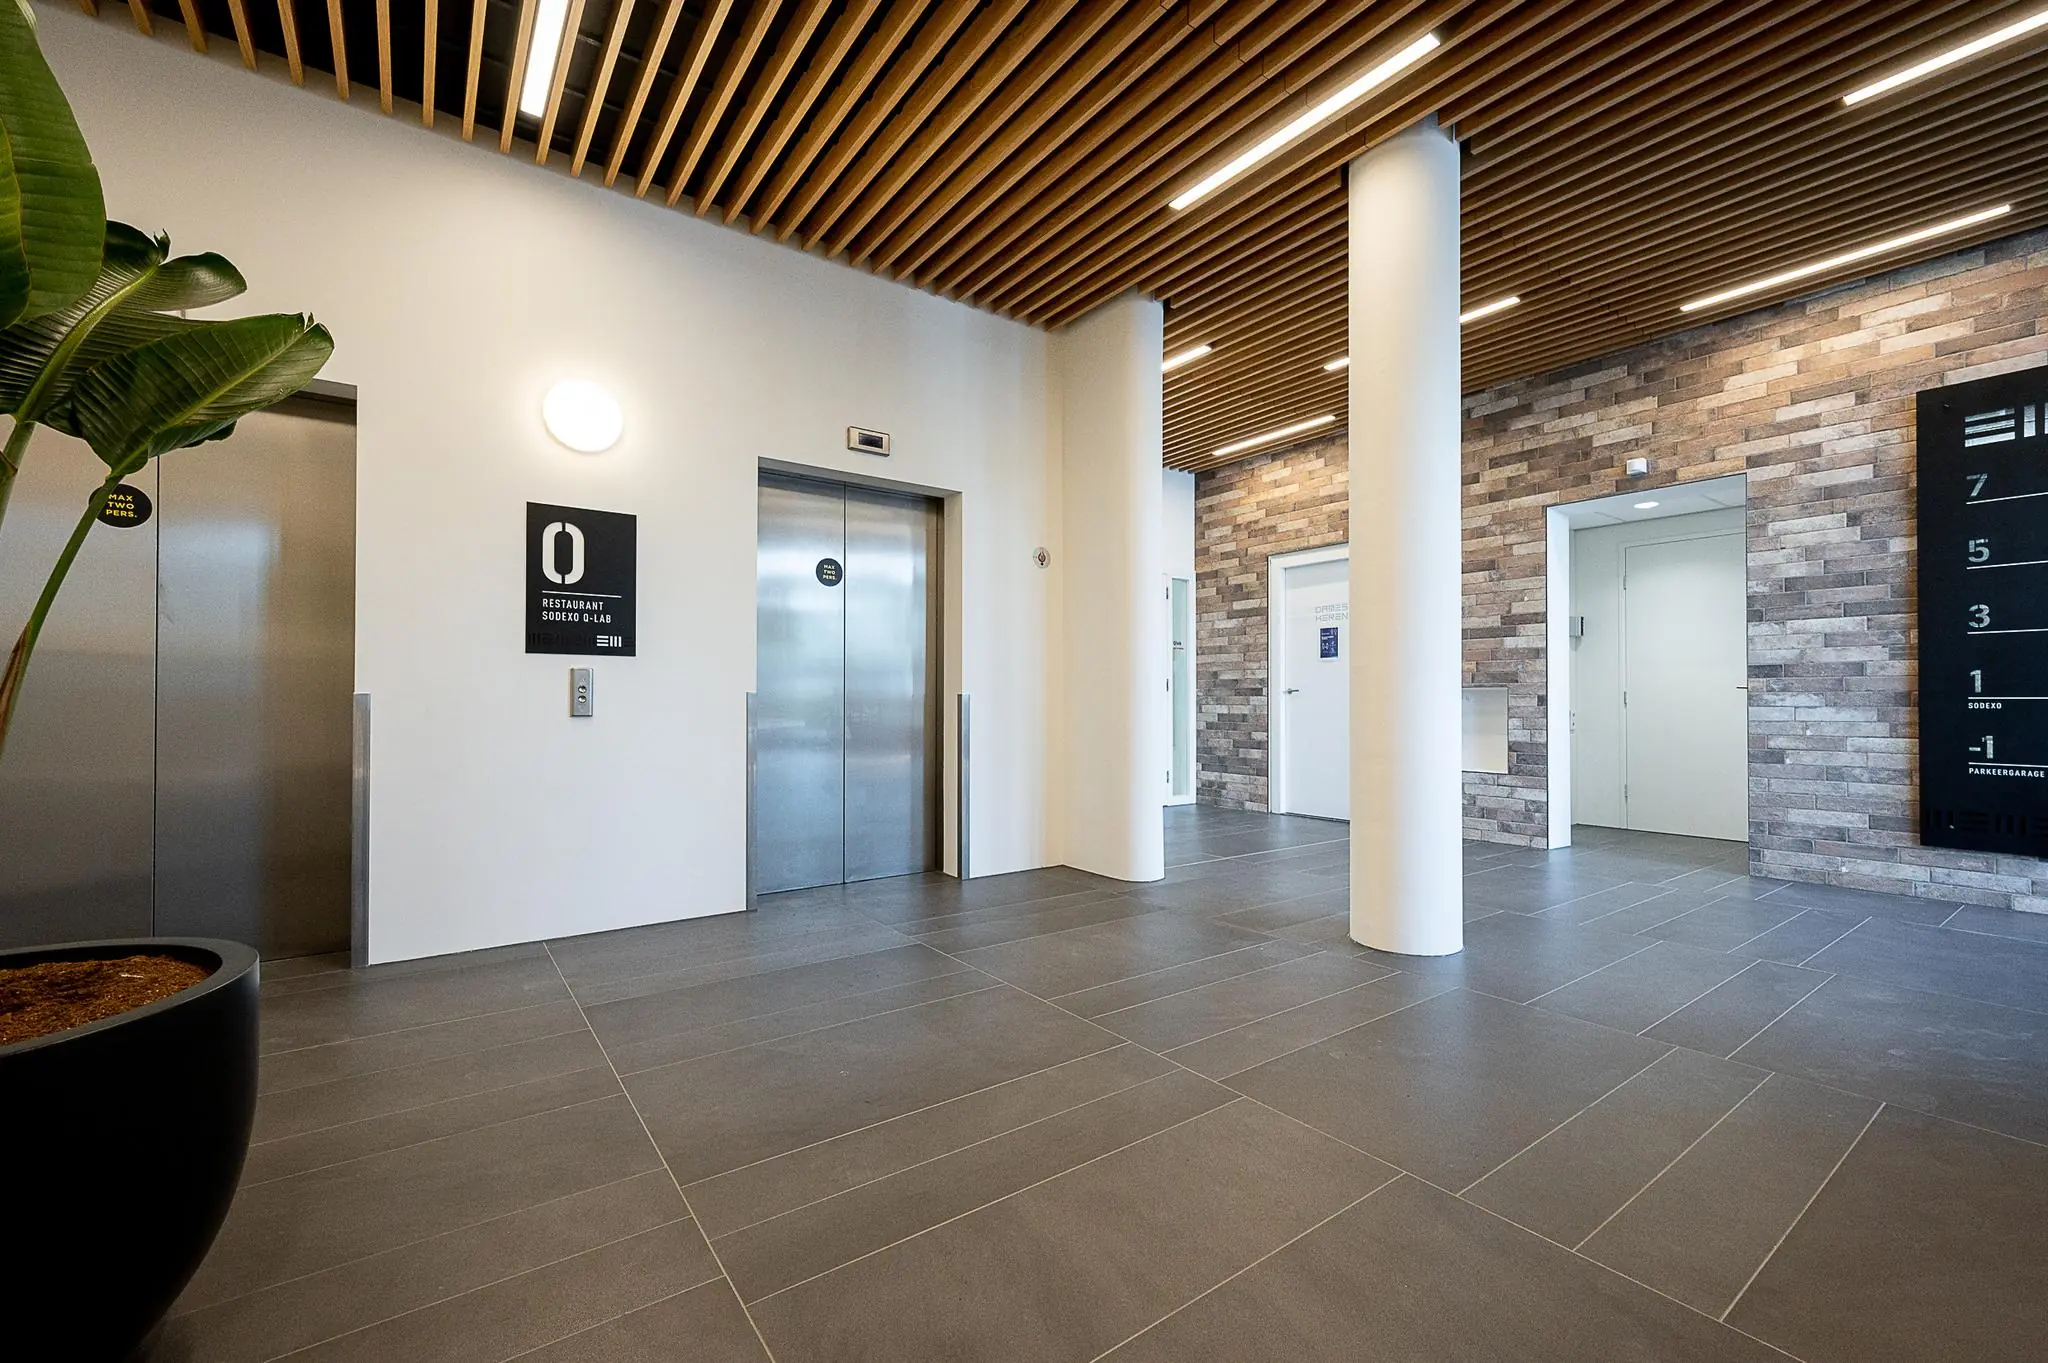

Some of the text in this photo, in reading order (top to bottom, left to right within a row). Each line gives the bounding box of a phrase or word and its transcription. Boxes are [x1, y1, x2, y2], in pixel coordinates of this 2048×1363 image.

[1966, 473, 1988, 497] 7
[108, 494, 133, 502] MAX
[107, 501, 135, 510] TWO
[105, 509, 138, 518] PERS.
[1968, 538, 1990, 563] 5
[542, 598, 604, 611] RESTAURANT
[542, 611, 612, 624] SODEXO Q-LAB
[1968, 604, 1991, 628] 3
[1970, 669, 1982, 693] 1
[1967, 702, 2002, 710] SODEXO
[1968, 735, 1994, 759] -1
[1968, 767, 2046, 778] PARKEERGARAGE
